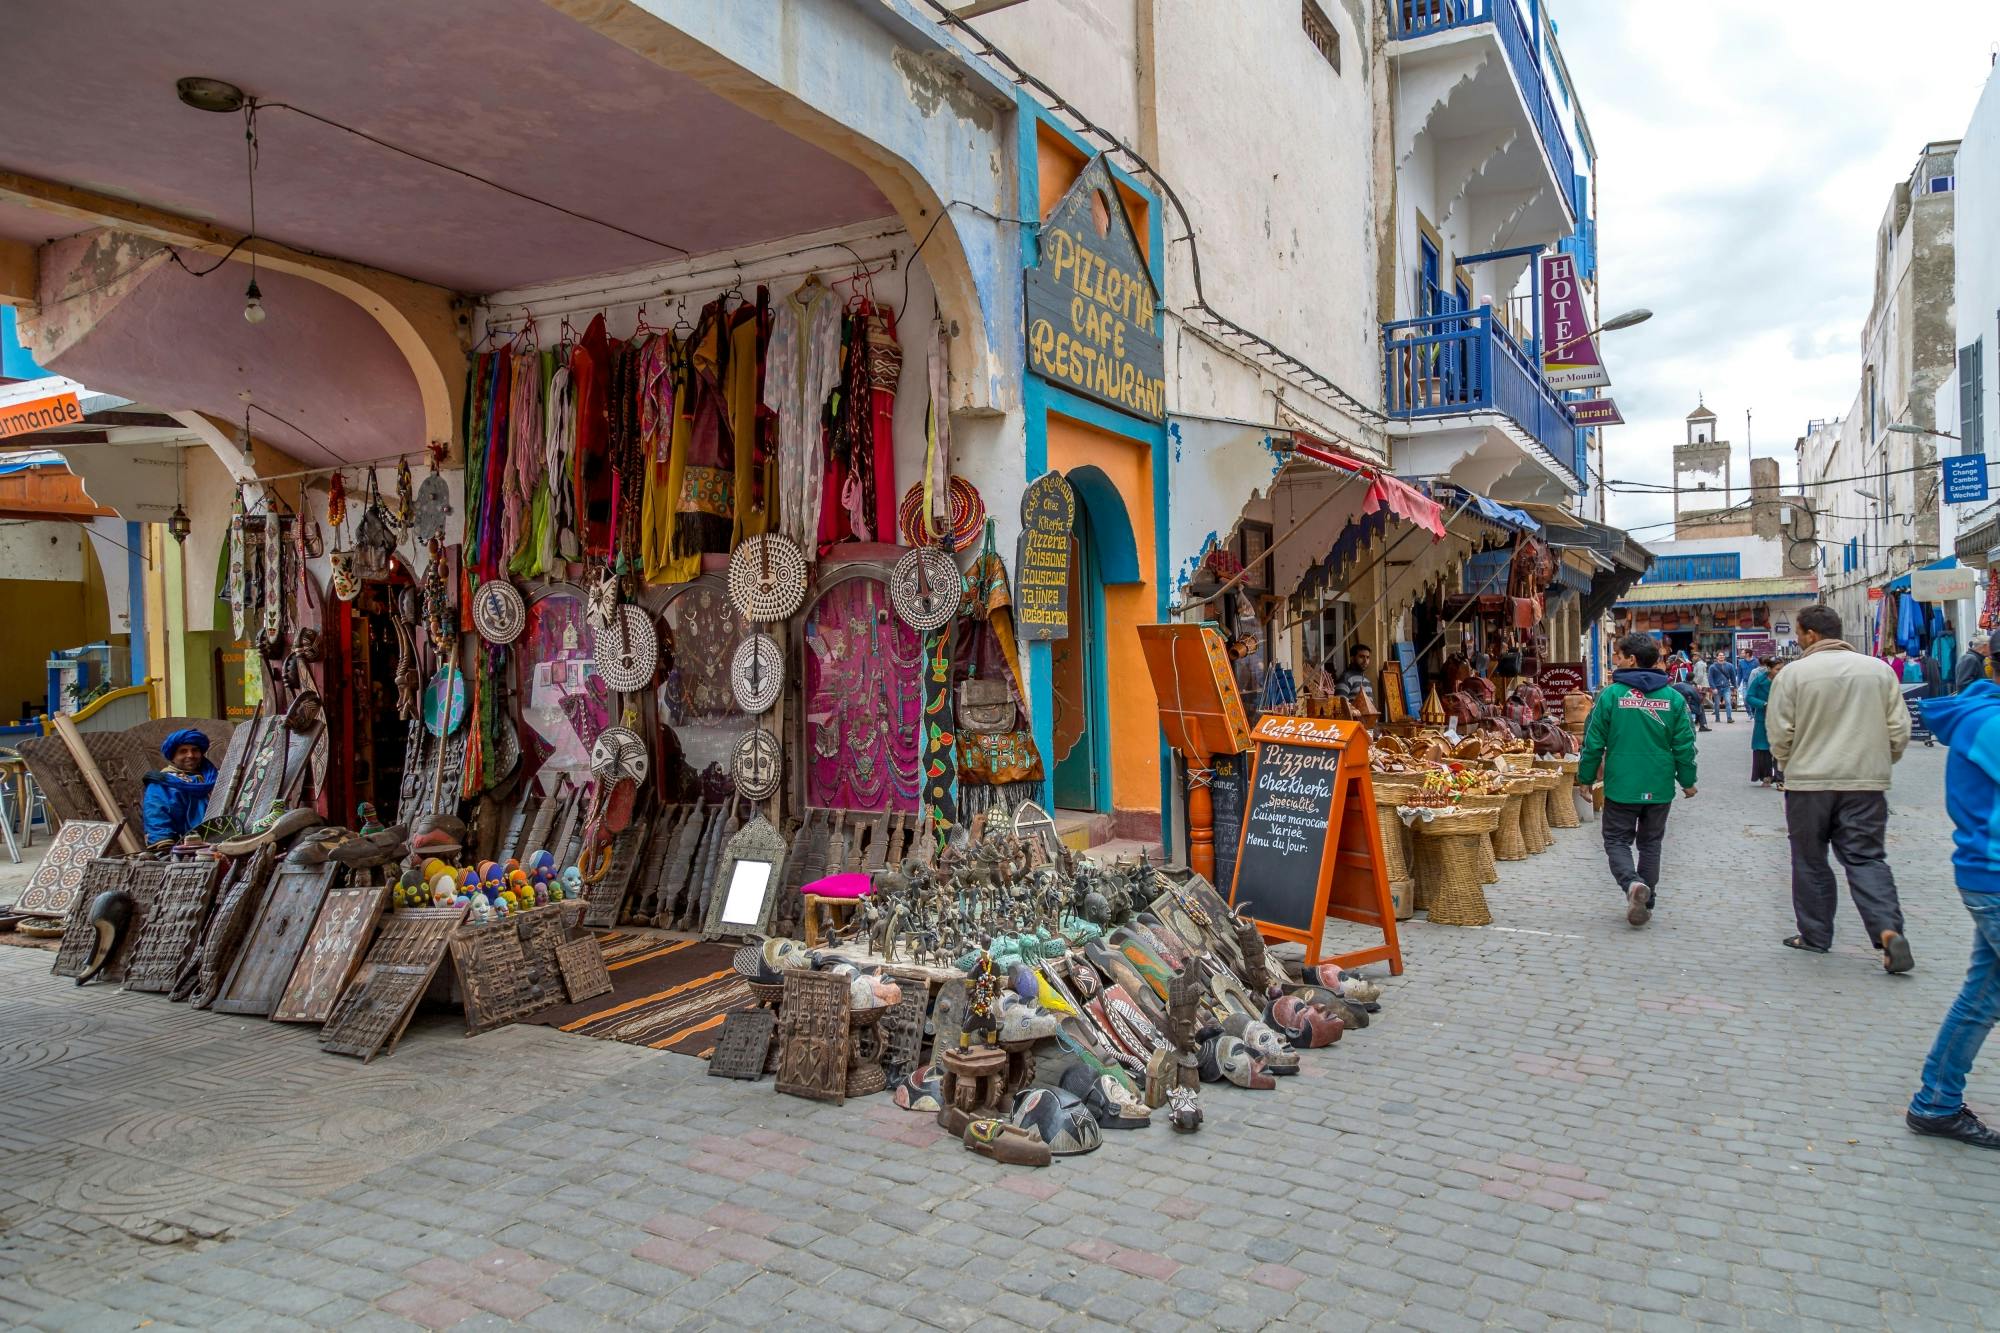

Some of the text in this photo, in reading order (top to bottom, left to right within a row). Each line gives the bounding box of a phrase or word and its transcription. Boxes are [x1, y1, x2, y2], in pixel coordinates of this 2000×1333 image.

[1549, 260, 1574, 361] HOTEL
[1071, 296, 1126, 360] CAFE
[1030, 318, 1166, 420] RESTAURANT
[1548, 371, 1601, 384] Dar Mounia
[1952, 476, 1979, 484] Cambio
[1952, 491, 1981, 499] Wechsel
[1262, 744, 1337, 778] Pizzeria
[1246, 832, 1269, 848] Menu
[1272, 836, 1286, 850] du
